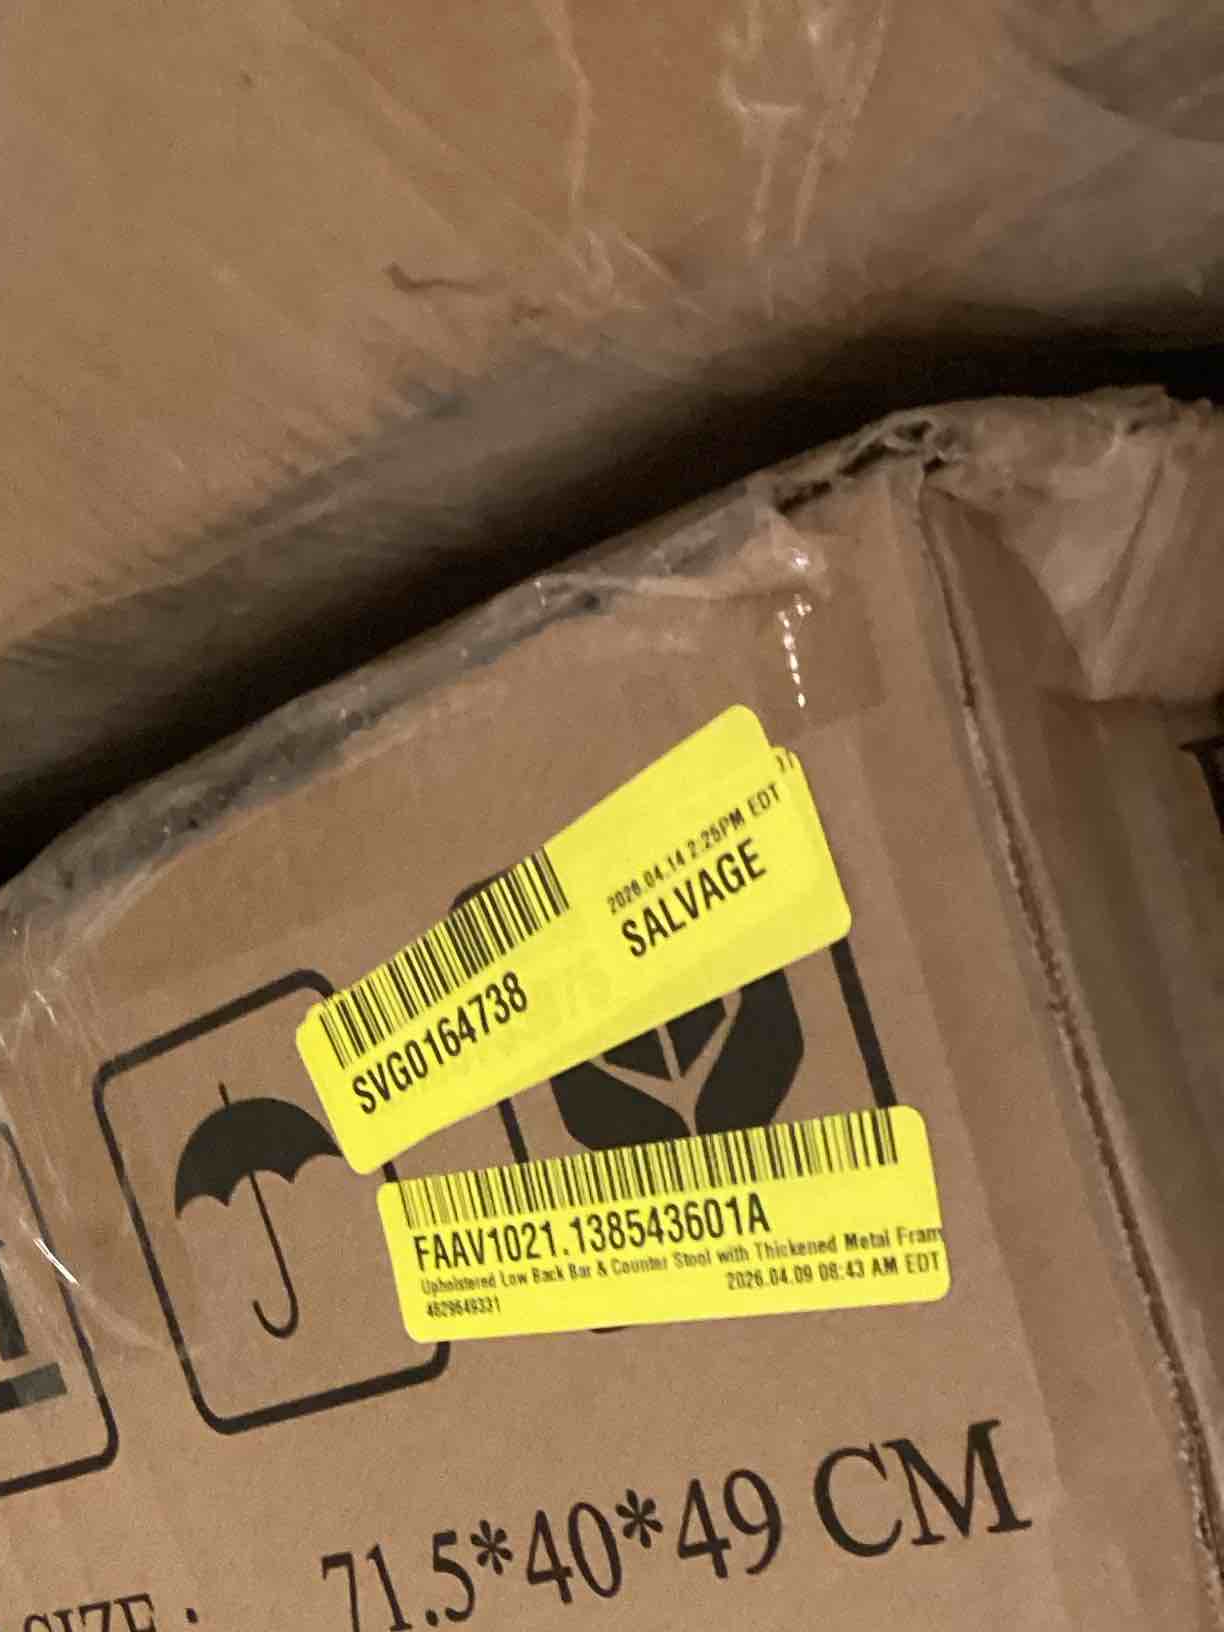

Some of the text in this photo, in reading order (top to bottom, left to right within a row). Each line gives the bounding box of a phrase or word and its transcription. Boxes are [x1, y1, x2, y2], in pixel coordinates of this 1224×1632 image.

[747, 783, 781, 818] EDT
[621, 837, 767, 957] SALVAGE
[352, 971, 528, 1114] SVG0164738
[413, 1192, 771, 1271] FAAV1021.138543601A
[420, 1271, 496, 1296] Upholstered
[500, 1271, 527, 1287] Low
[532, 1264, 563, 1284] Back
[568, 1263, 591, 1280] Bar
[597, 1260, 608, 1277] &
[610, 1256, 667, 1275] Counter
[674, 1248, 712, 1269] Stool
[717, 1245, 749, 1265] with
[754, 1234, 837, 1261] Thickened
[844, 1228, 890, 1251] Metal
[726, 1251, 940, 1290] 2026.04.09 08:43 AM EDT
[812, 1417, 1033, 1558] CM
